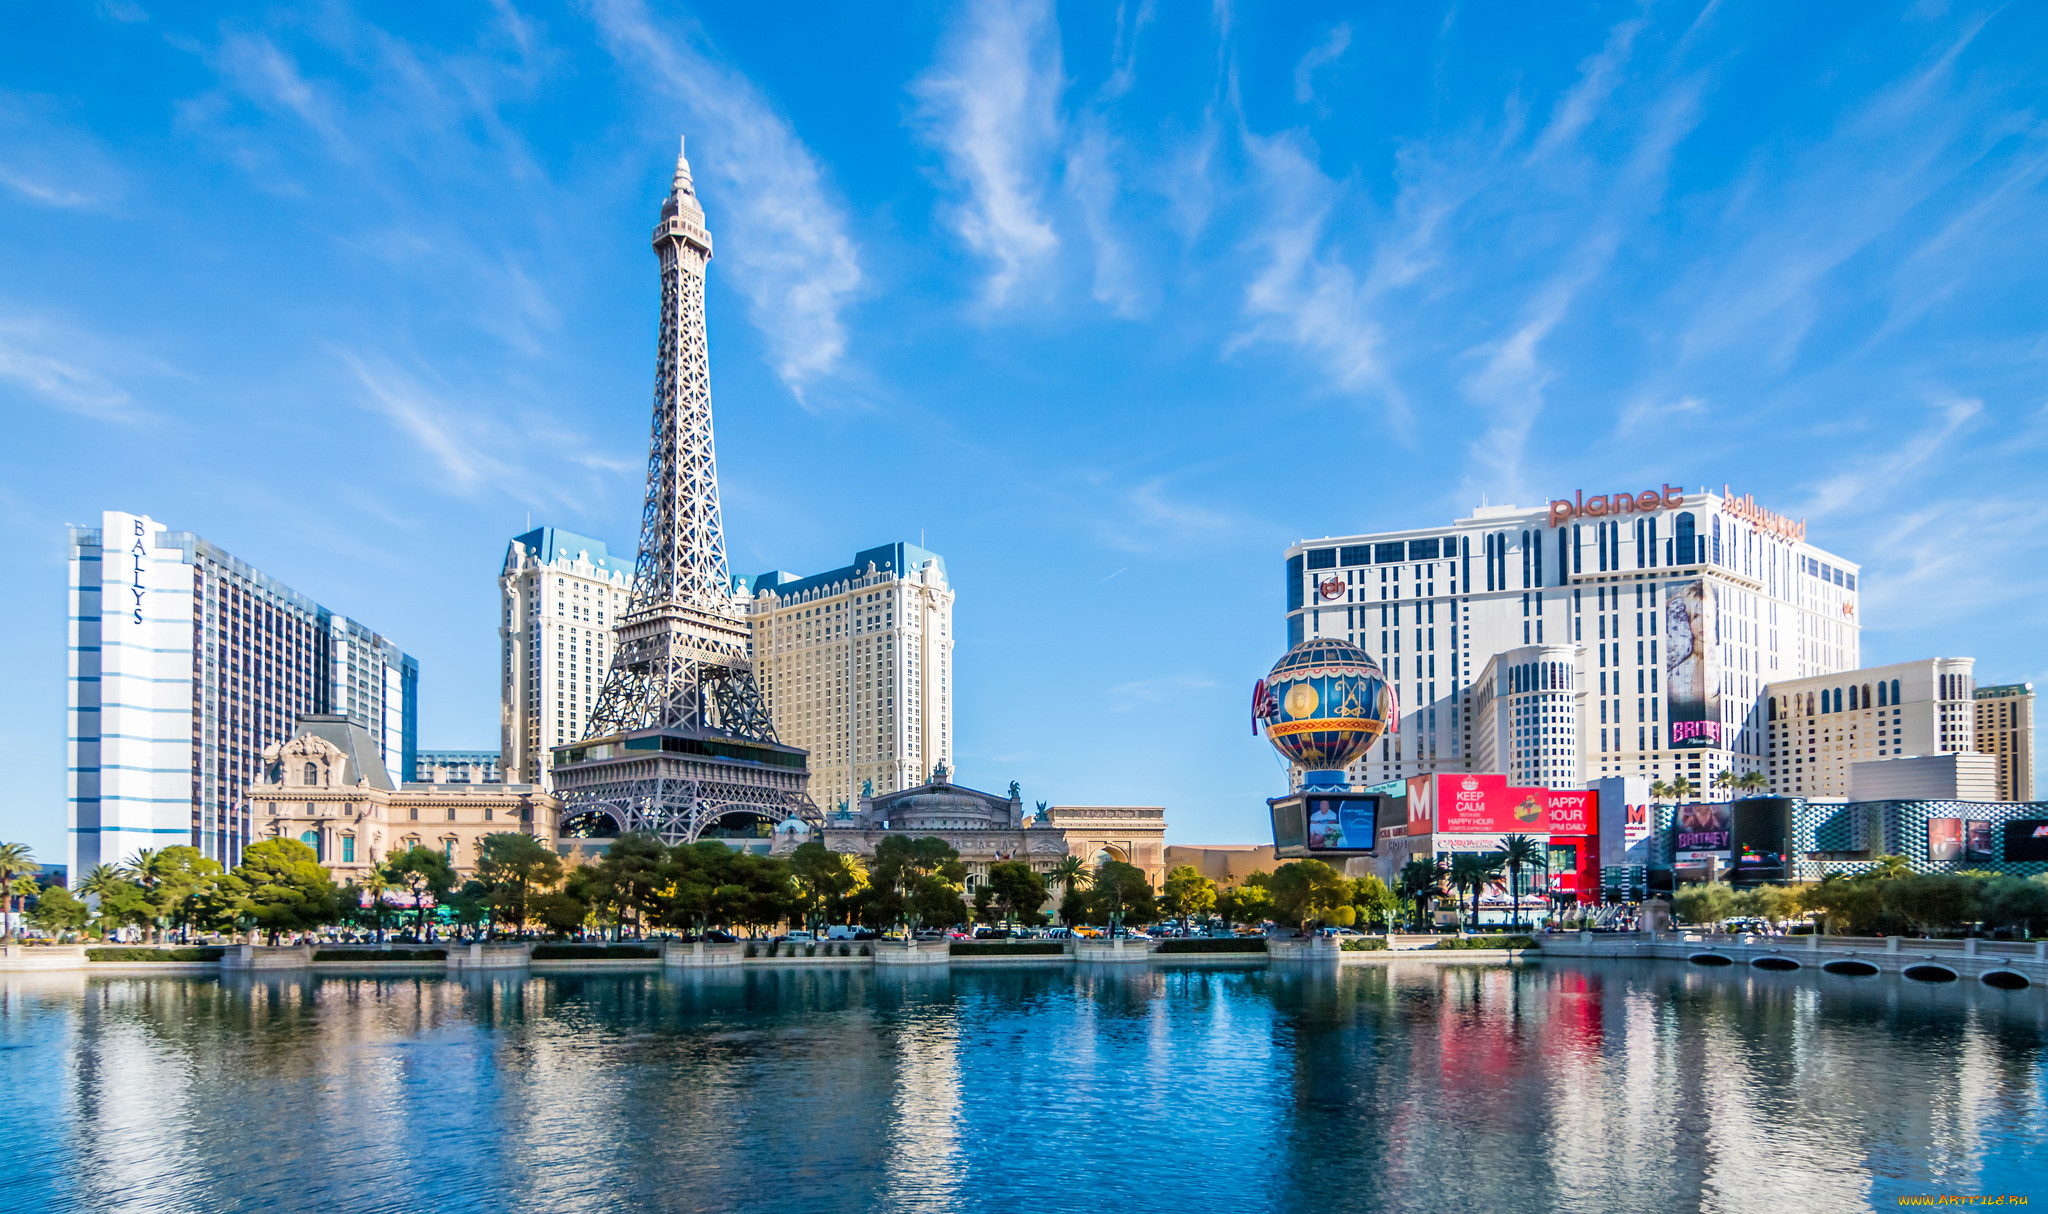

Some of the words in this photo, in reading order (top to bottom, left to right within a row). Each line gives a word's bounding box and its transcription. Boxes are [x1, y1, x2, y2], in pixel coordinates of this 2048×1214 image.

[1550, 484, 1683, 527] planet
[1723, 484, 1806, 543] hollywood
[1409, 781, 1430, 822] M
[1456, 791, 1484, 801] KEEP
[1455, 801, 1485, 812] CALM
[1626, 803, 1646, 823] M
[1565, 823, 1588, 831] DAILY
[1678, 831, 1729, 848] BRITNEY
